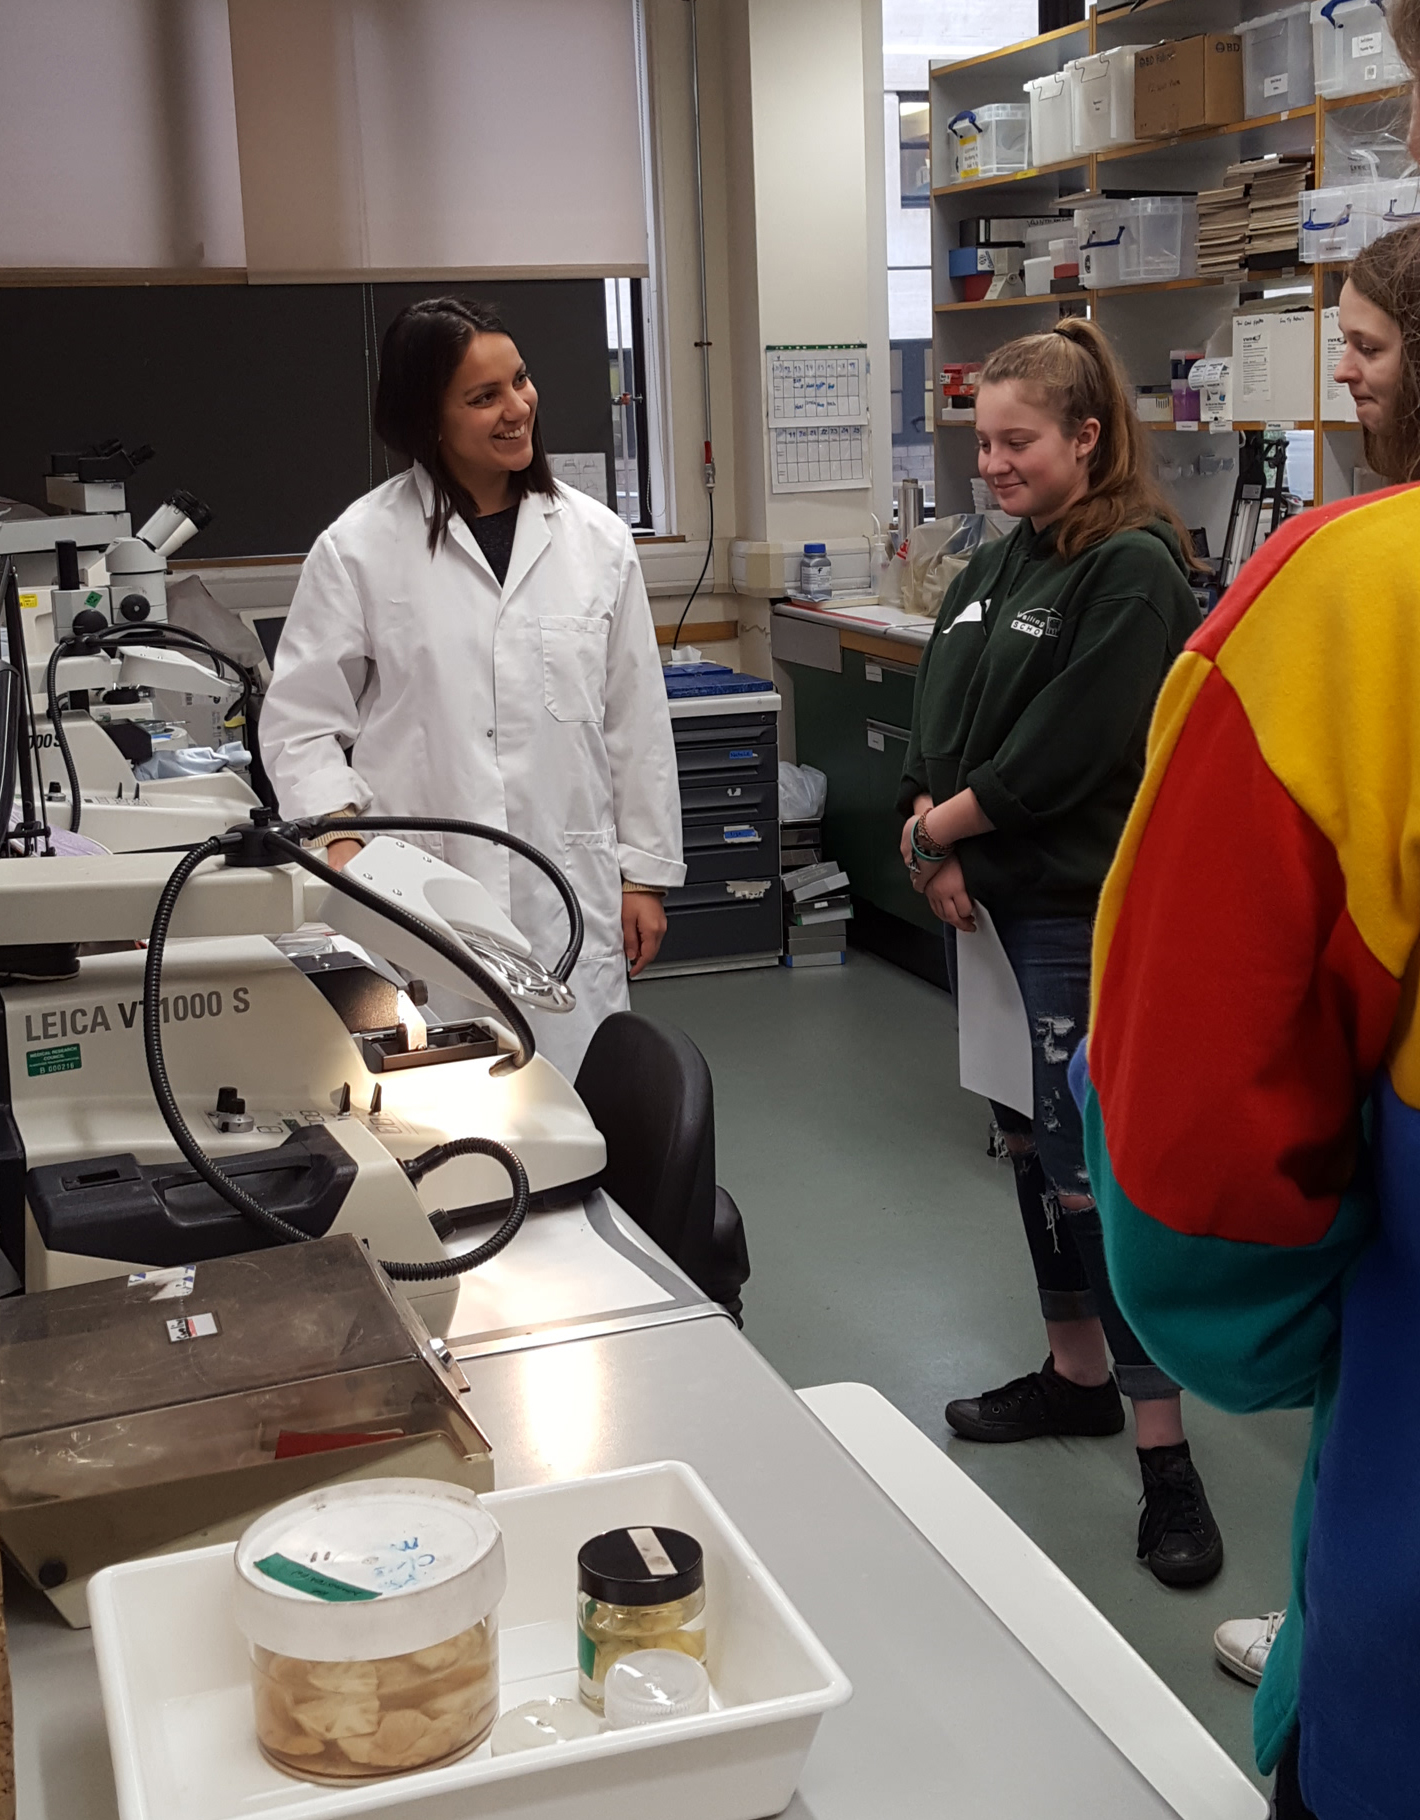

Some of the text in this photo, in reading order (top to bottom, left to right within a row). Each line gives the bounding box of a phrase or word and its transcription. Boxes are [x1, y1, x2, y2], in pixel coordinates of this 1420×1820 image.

[1226, 42, 1240, 52] BD
[25, 987, 250, 1042] LEICA V1000 S
[51, 1046, 78, 1054] RESEARCH
